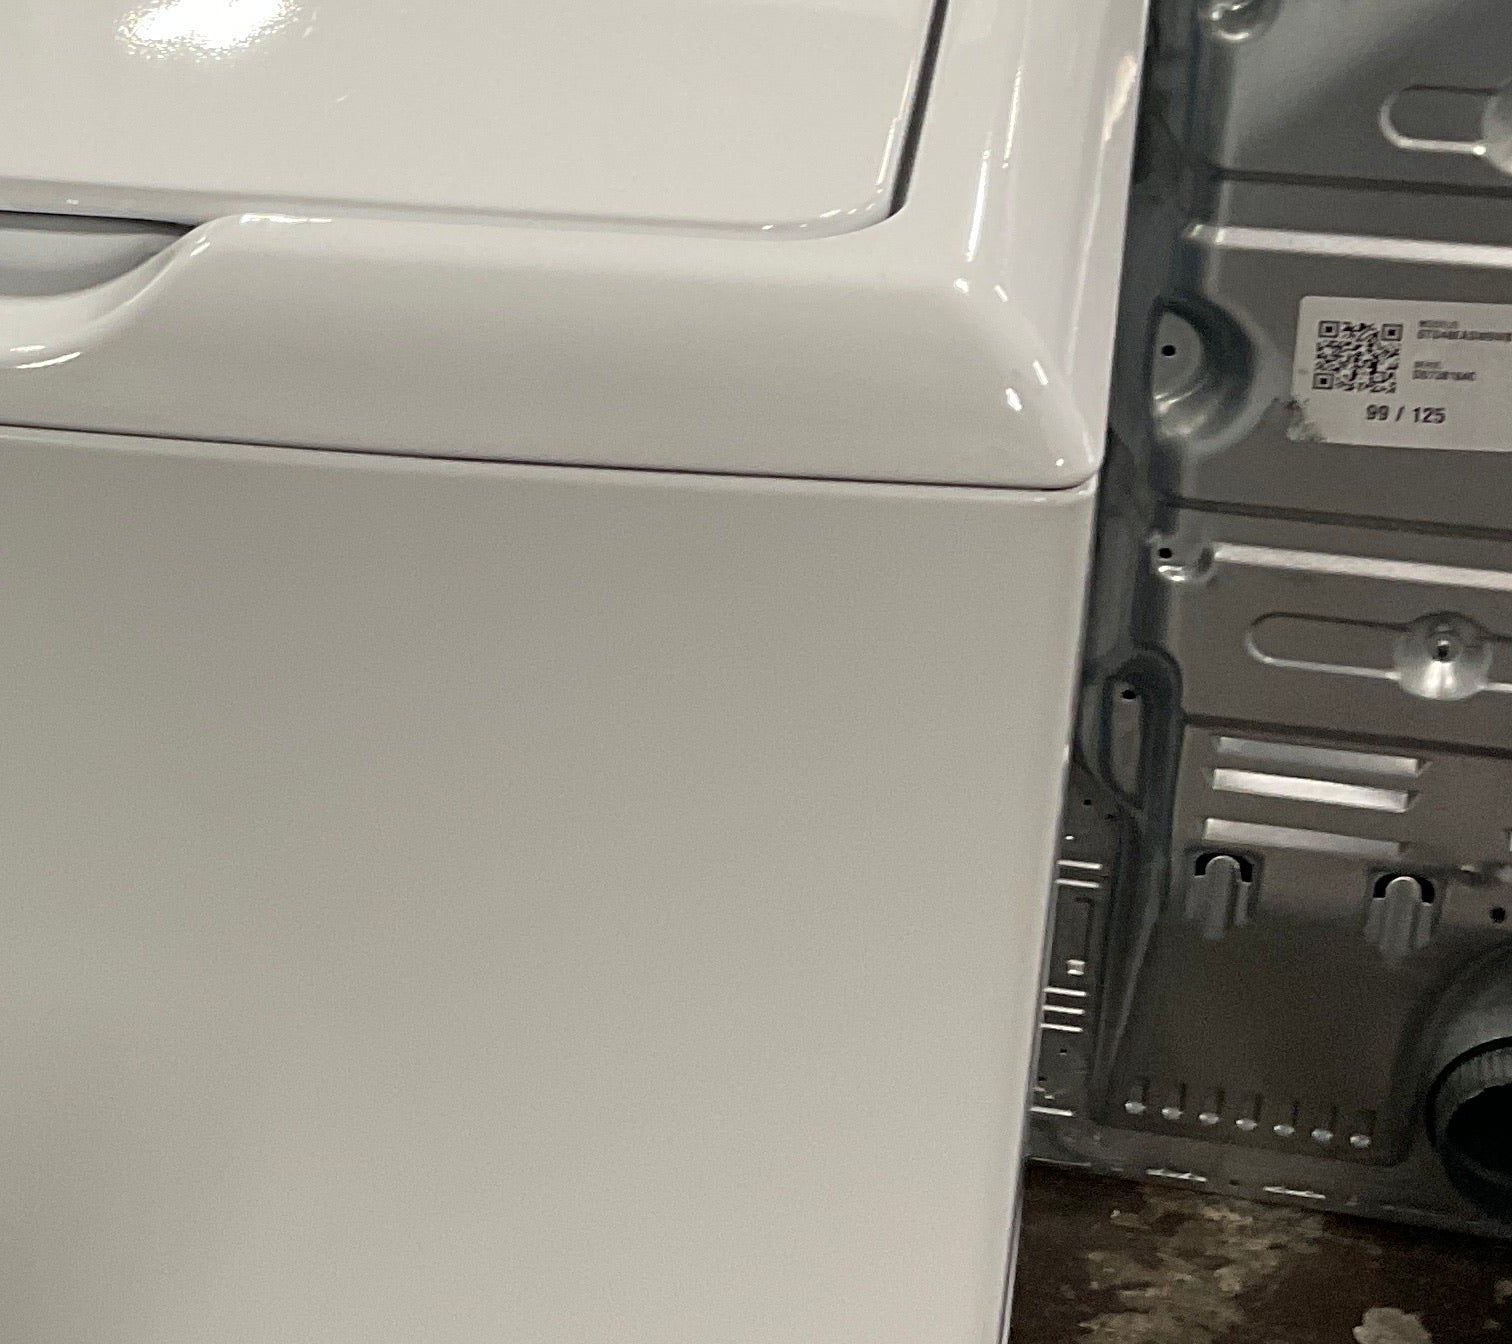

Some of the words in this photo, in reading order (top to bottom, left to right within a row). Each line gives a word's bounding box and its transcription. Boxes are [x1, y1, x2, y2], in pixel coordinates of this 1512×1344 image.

[1365, 405, 1389, 421] 99
[1394, 406, 1405, 422] /
[1412, 406, 1446, 424] 125
